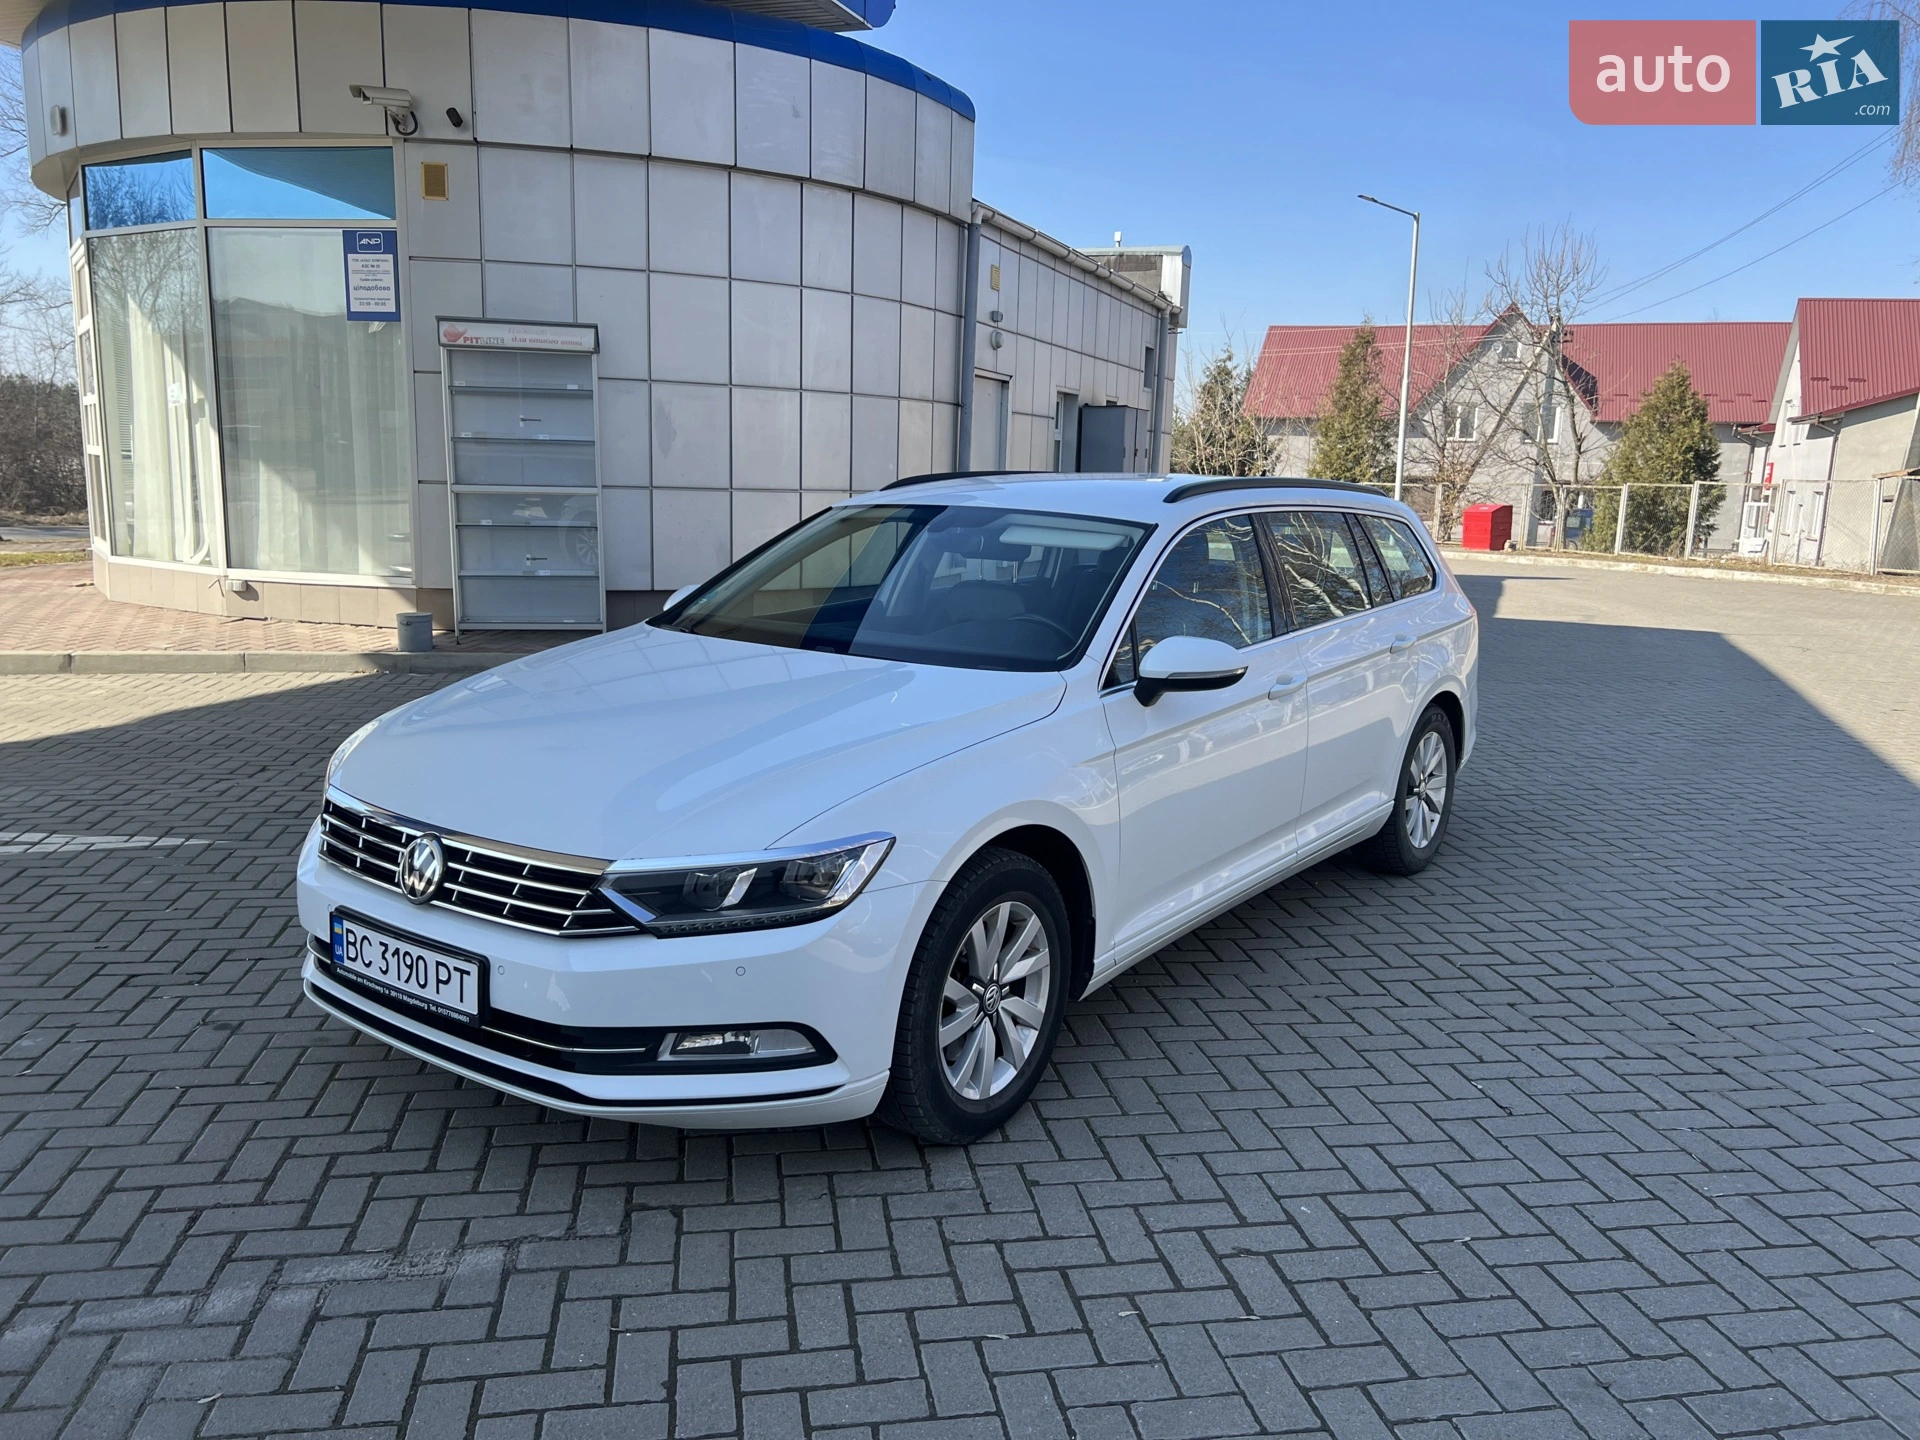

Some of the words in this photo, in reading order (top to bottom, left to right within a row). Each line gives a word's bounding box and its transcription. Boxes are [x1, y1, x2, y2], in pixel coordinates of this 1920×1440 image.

[353, 284, 391, 292] цілодобово
[335, 944, 343, 956] UA
[345, 928, 372, 968] BC
[378, 940, 428, 989] 3190
[435, 959, 471, 1004] PT
[336, 967, 357, 981] Automobile
[403, 994, 428, 1010] Magdeburg
